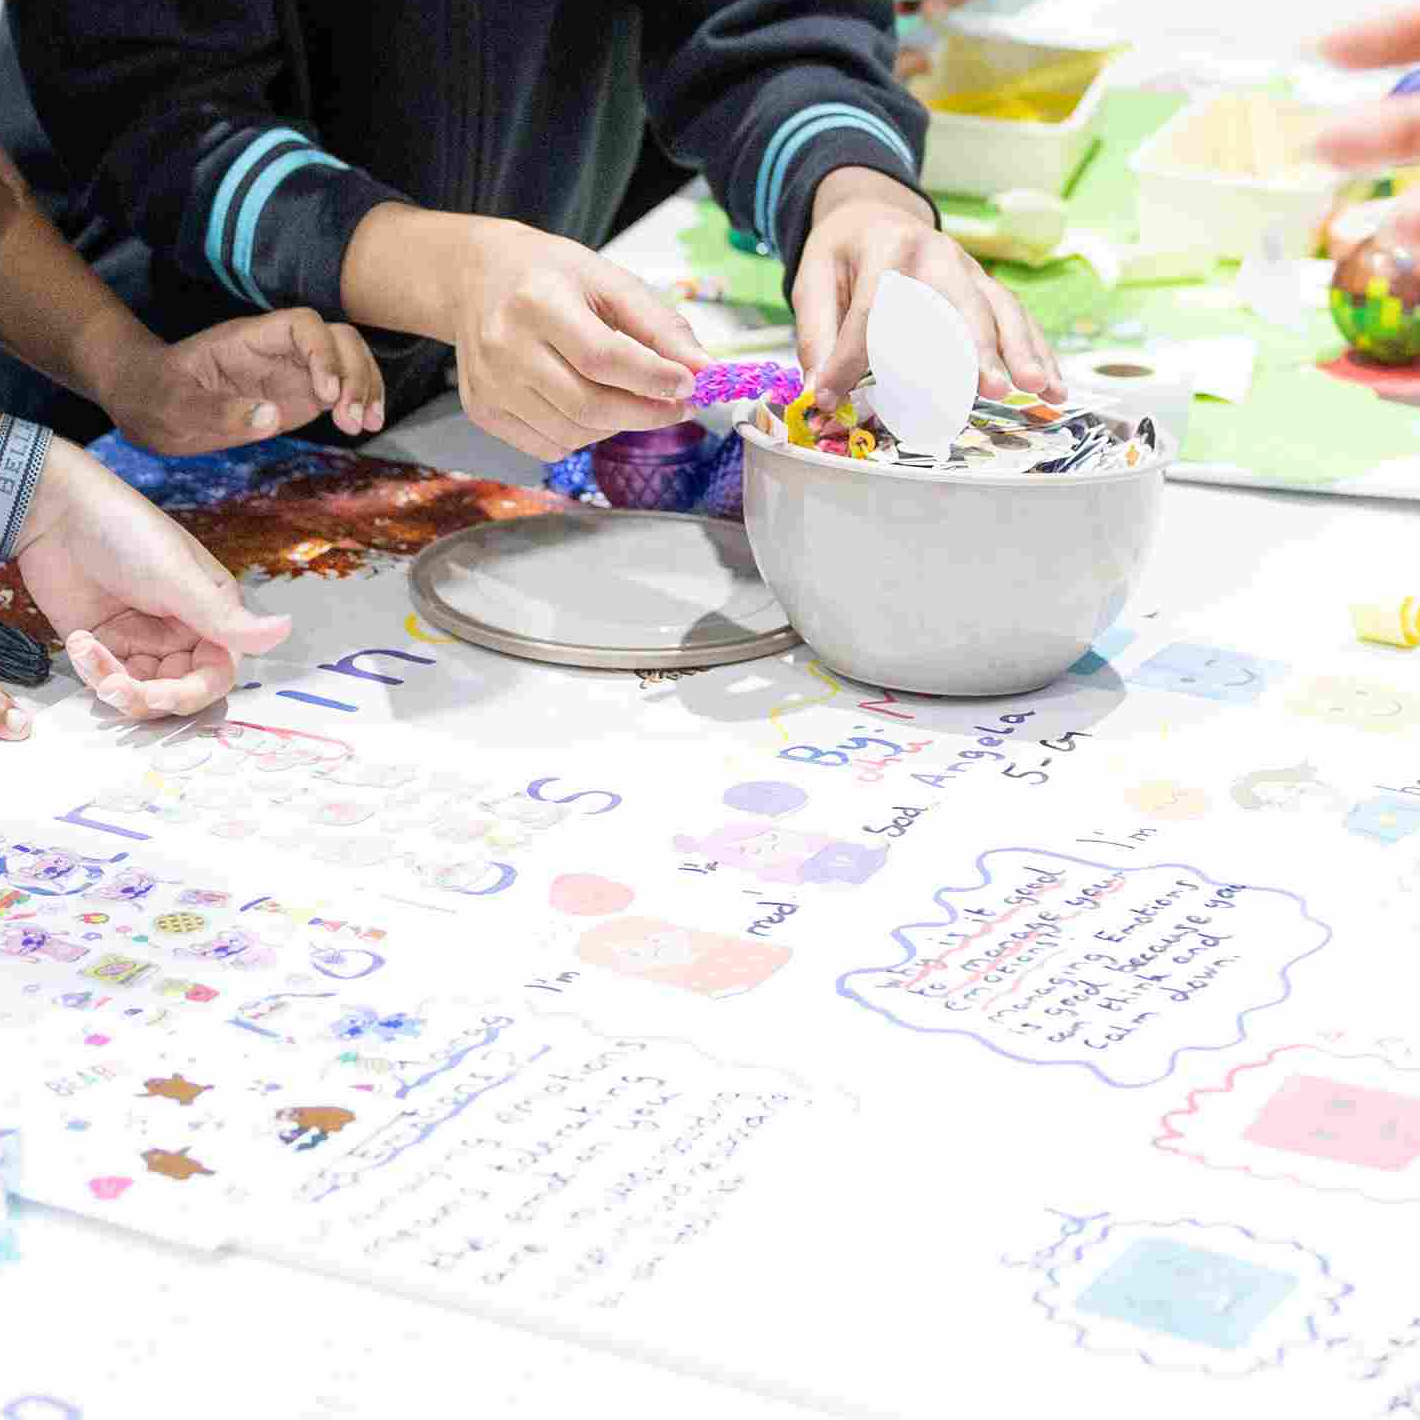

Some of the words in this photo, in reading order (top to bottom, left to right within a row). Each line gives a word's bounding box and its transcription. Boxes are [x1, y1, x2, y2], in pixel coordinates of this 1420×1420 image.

[910, 710, 1036, 789] Angela
[1004, 867, 1066, 906] good
[1093, 879, 1199, 943] Emotions
[1043, 978, 1110, 1017] good
[1104, 914, 1212, 974] because
[1204, 884, 1248, 909] you
[1097, 973, 1173, 1012] think
[1172, 932, 1236, 964] and
